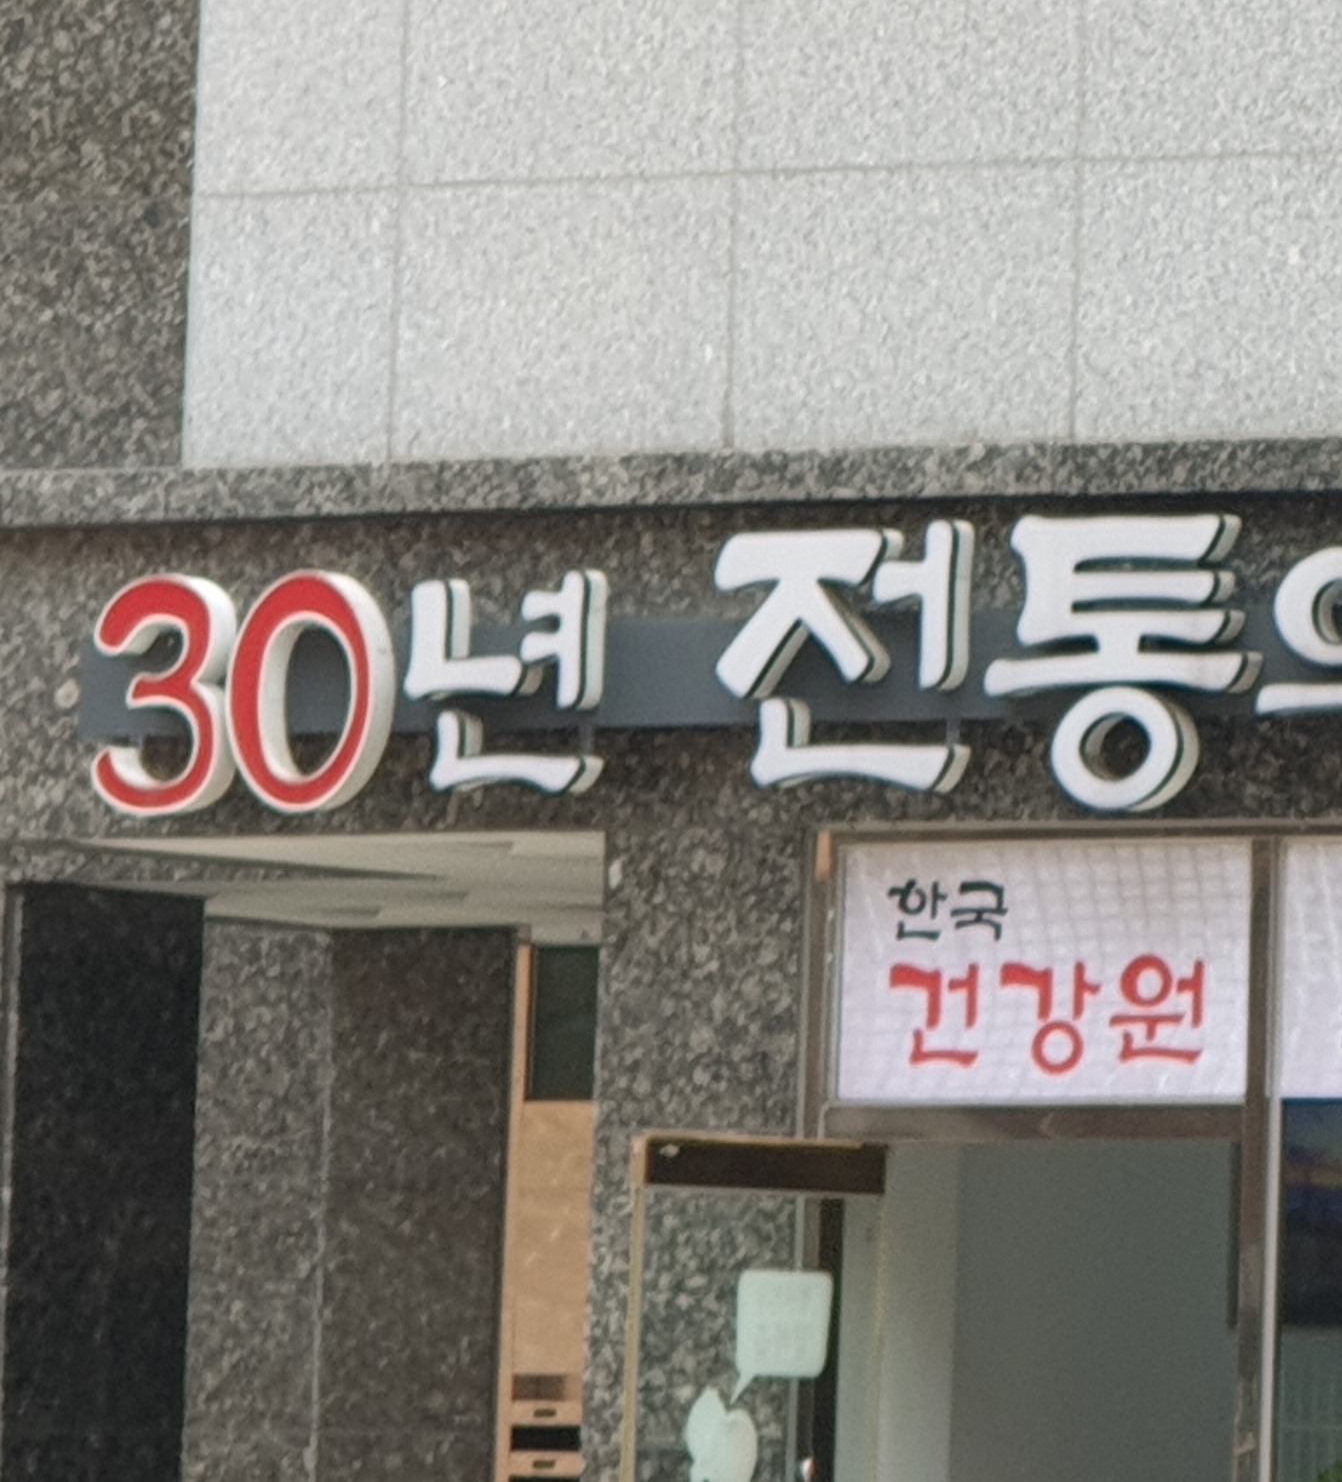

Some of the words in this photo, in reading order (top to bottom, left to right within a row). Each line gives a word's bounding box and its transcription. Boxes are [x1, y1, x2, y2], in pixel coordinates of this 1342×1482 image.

[92, 569, 607, 816] 30년
[888, 878, 1008, 941] 한국
[889, 953, 1205, 1075] 건강원
